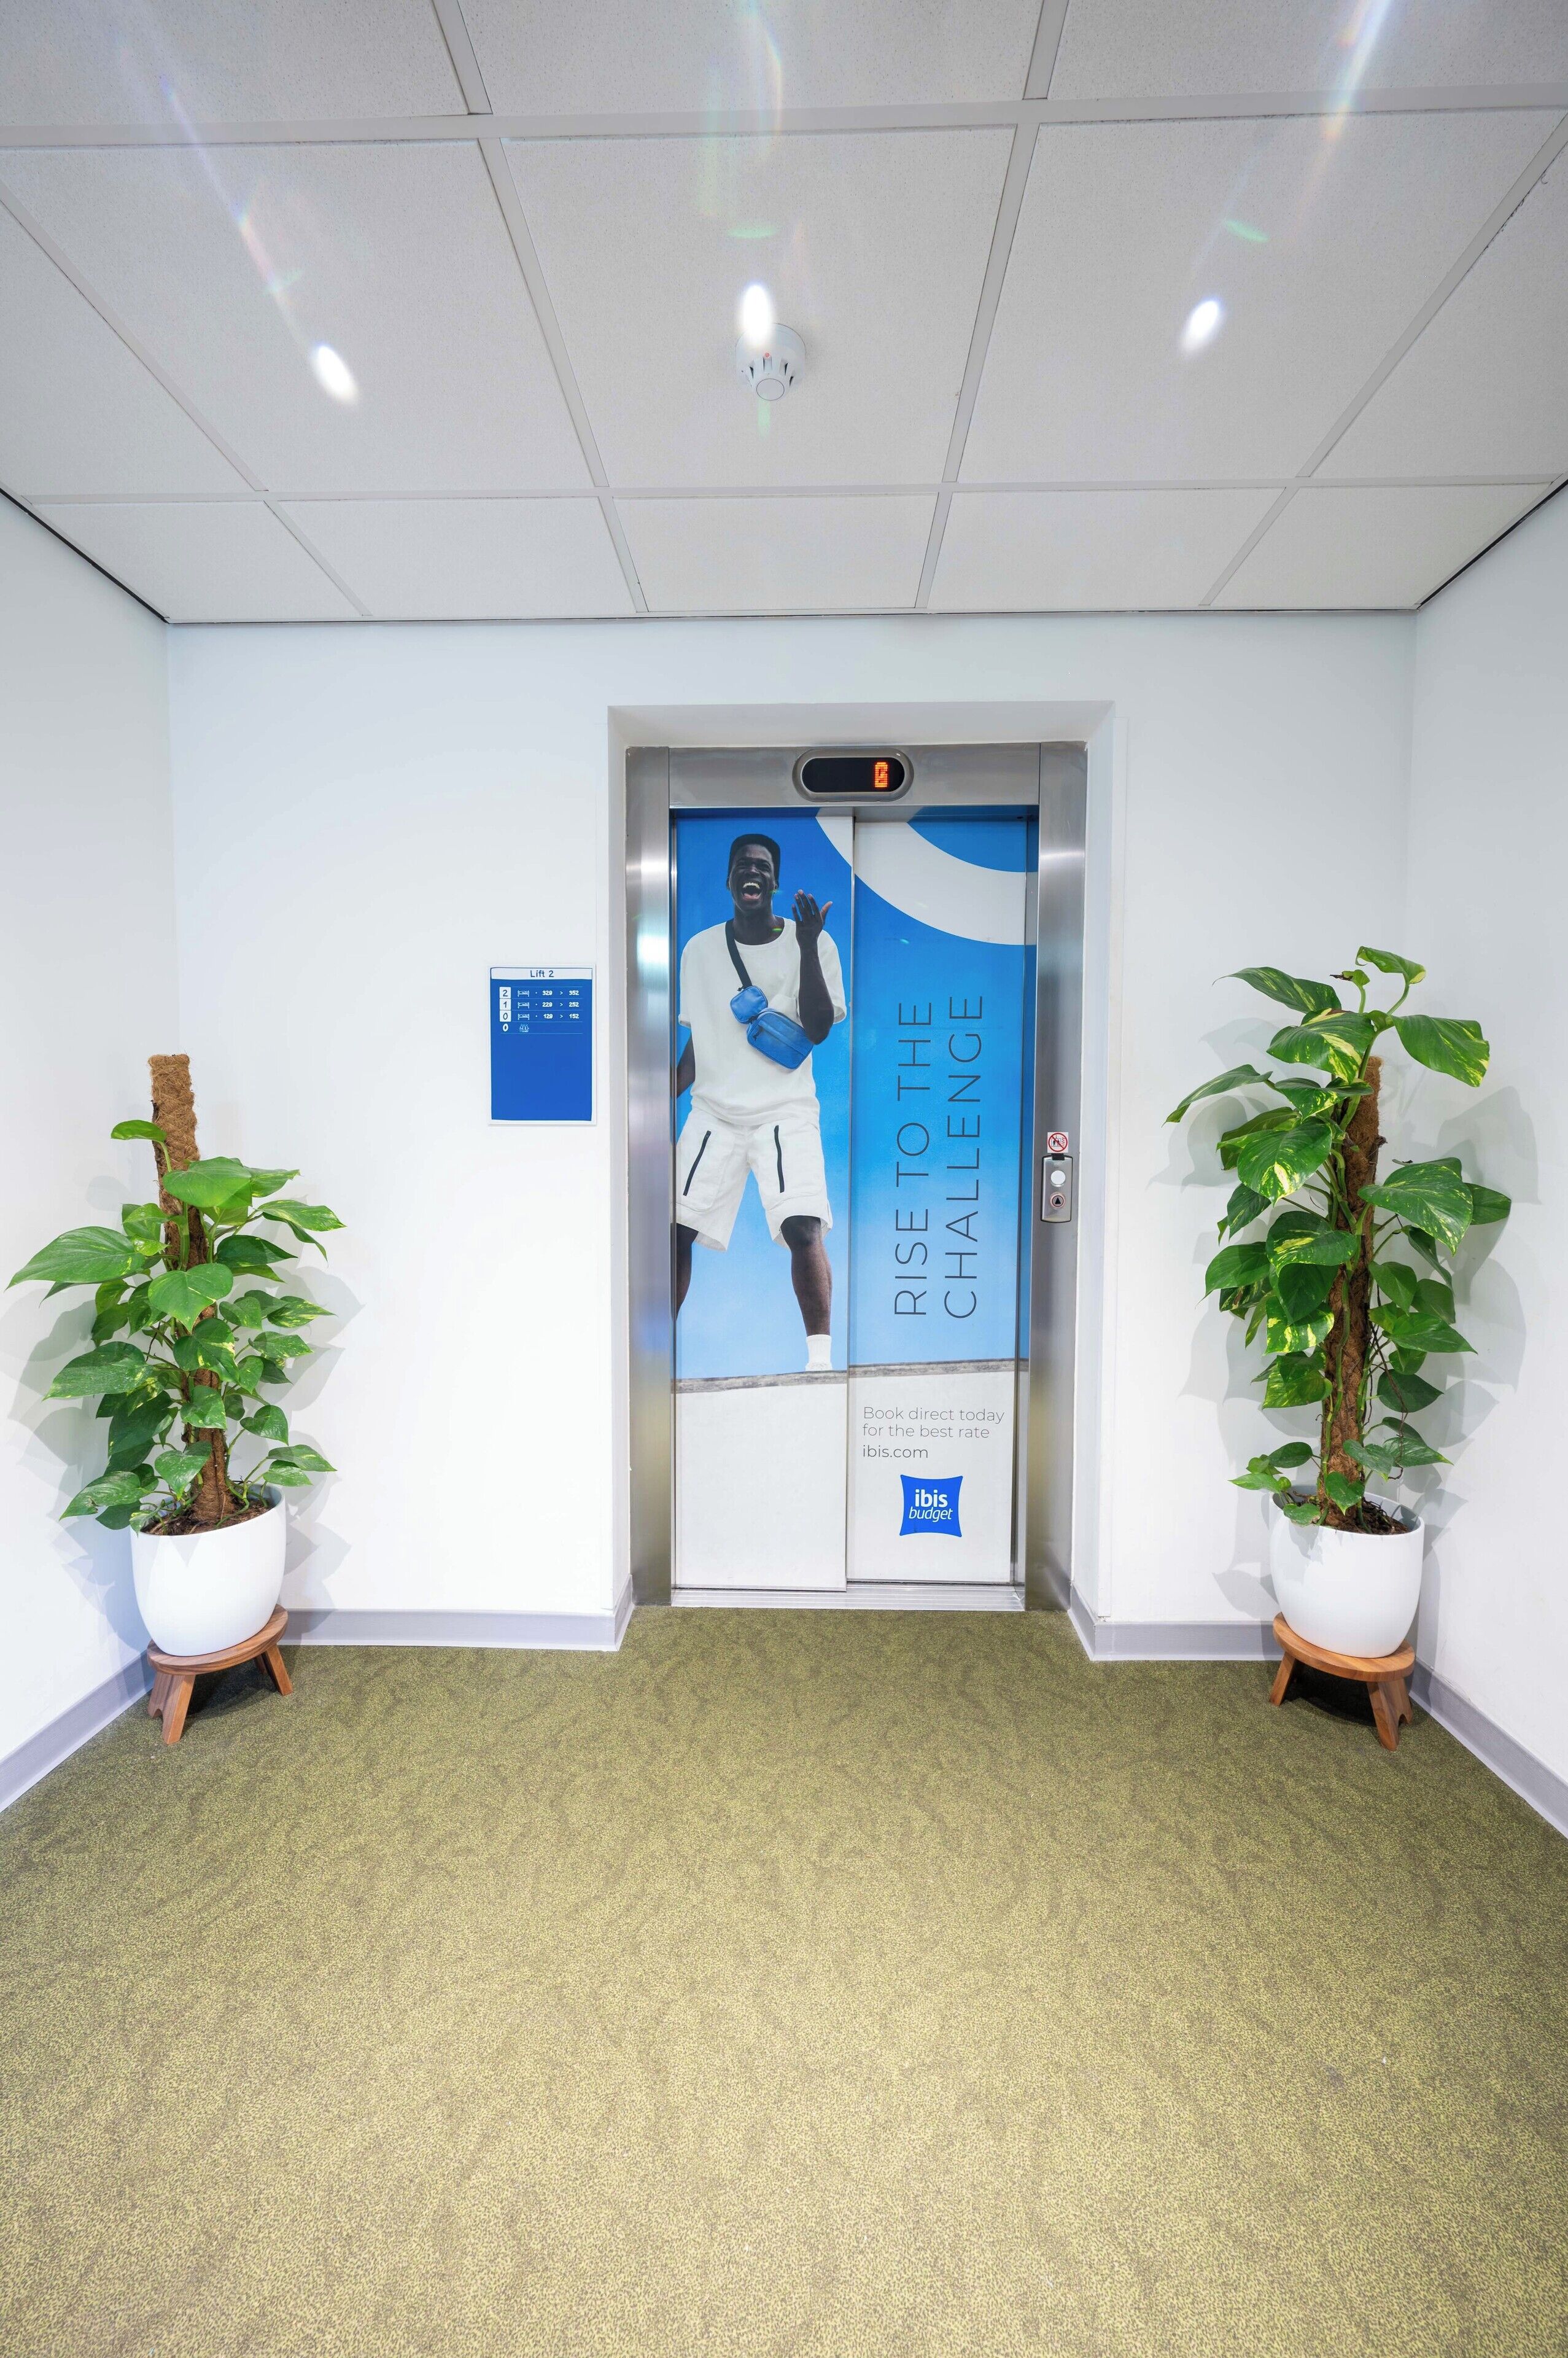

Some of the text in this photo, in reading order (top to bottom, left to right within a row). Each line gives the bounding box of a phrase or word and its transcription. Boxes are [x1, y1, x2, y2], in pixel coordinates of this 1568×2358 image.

[502, 1023, 509, 1032] 0
[895, 1002, 932, 1315] RISE TO THE
[944, 995, 983, 1318] CHALLENGE
[864, 1406, 1005, 1425] Book direct today
[862, 1423, 990, 1439] for the best rate
[863, 1444, 928, 1459] ibis.com
[914, 1488, 948, 1508] ibis
[909, 1506, 953, 1523] budget
